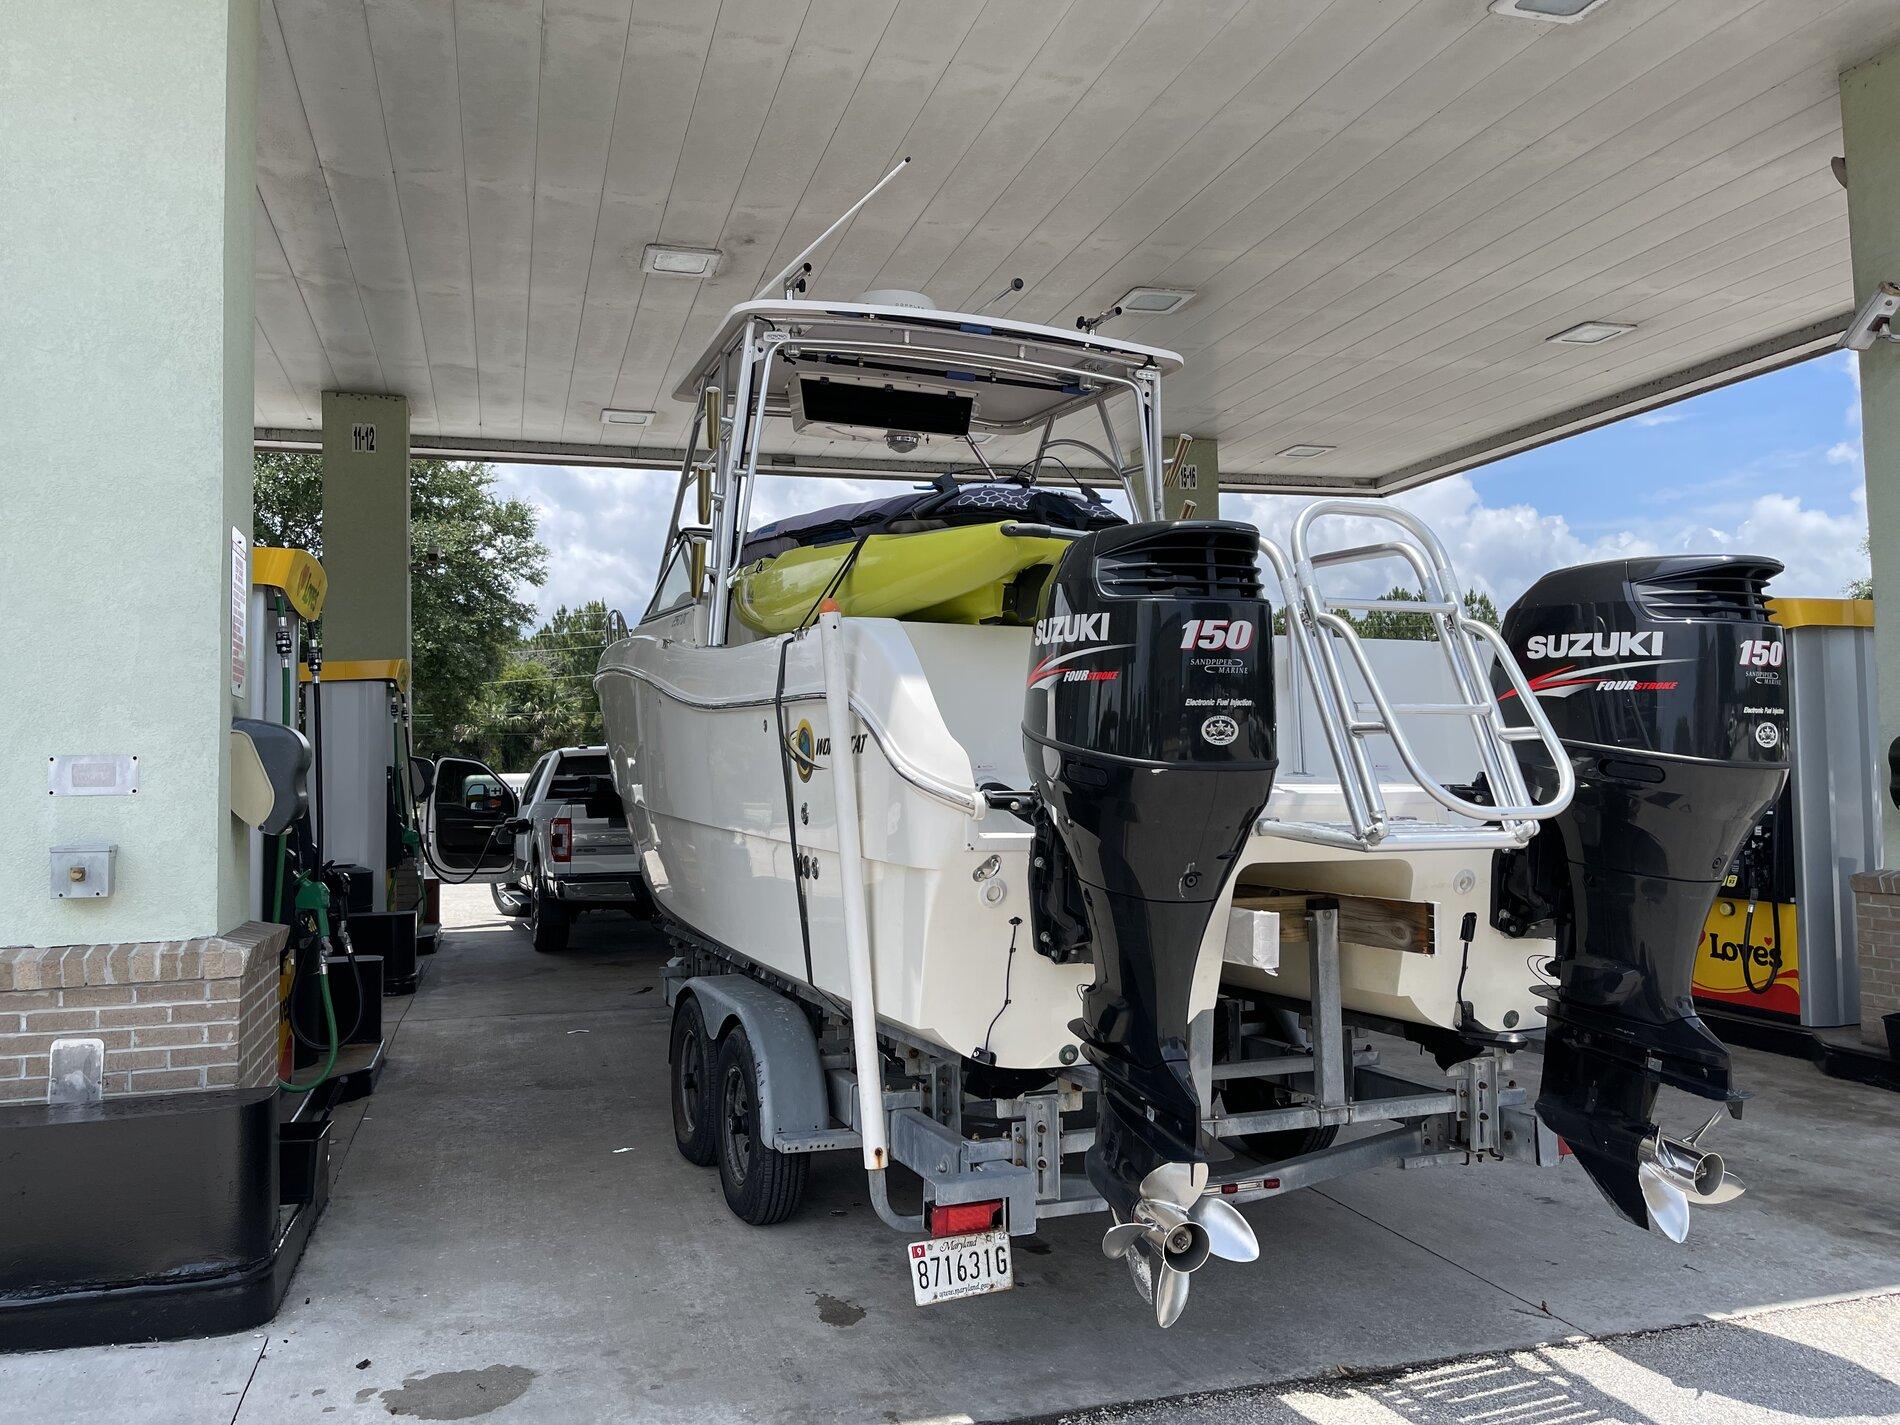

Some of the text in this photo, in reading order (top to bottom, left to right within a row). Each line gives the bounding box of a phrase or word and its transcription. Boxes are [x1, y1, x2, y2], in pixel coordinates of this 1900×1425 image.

[353, 426, 375, 451] 11-12
[1180, 466, 1196, 488] 15-16
[1035, 612, 1110, 646] SUZUKI
[1180, 619, 1254, 651] 150
[1526, 631, 1664, 660] SUZUKI
[1739, 639, 1784, 667] 150
[1190, 658, 1232, 666] SANDPIPER
[1185, 698, 1253, 708] Electronic Fuel Injection
[917, 1247, 922, 1257] 9
[940, 1237, 978, 1253] Maryland
[917, 1245, 1007, 1290] 871631G
